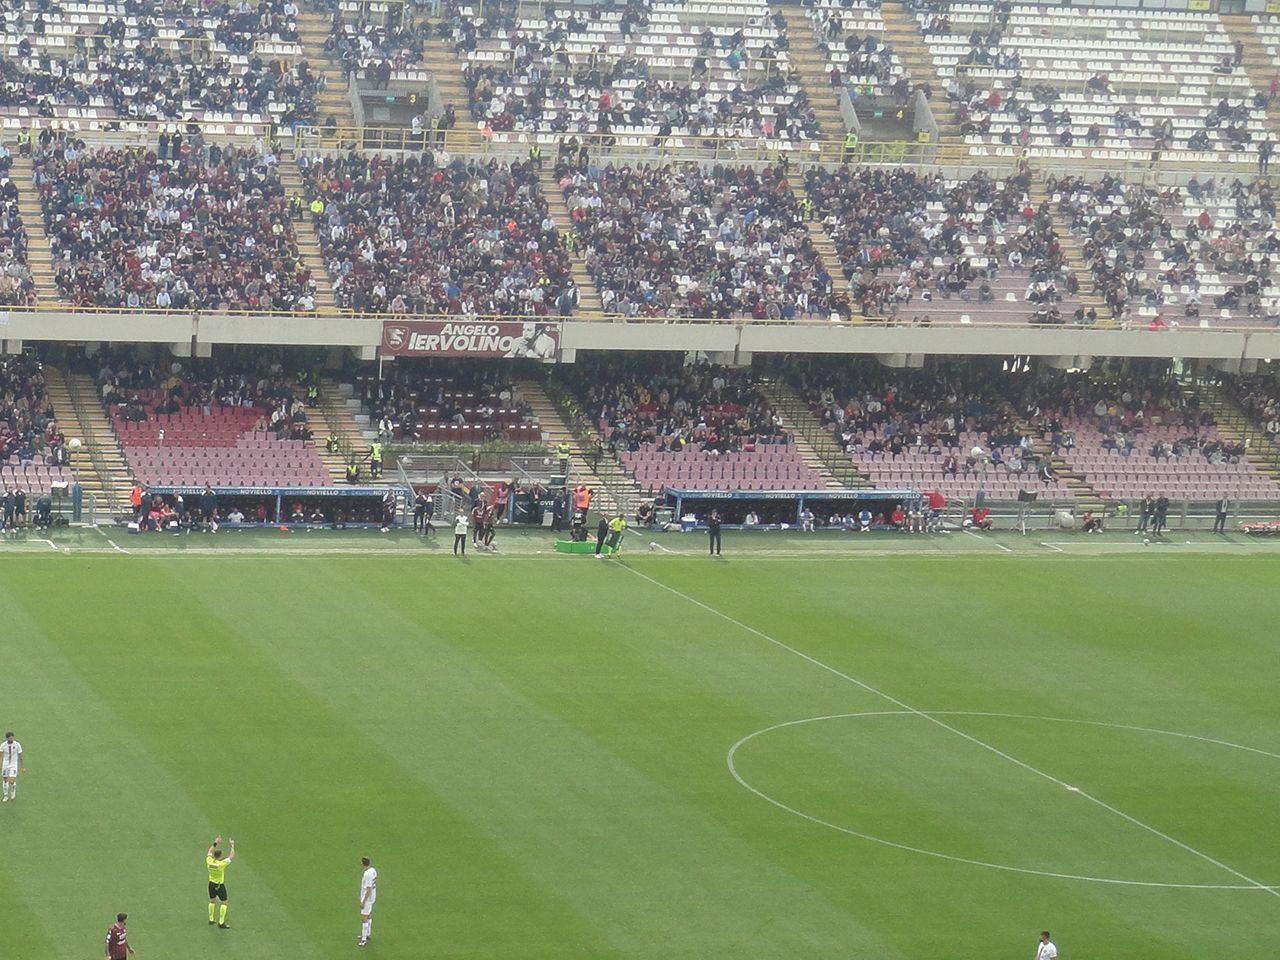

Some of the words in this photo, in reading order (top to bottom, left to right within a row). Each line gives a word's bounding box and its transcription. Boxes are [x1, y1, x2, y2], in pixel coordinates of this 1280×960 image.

[409, 94, 416, 103] 3
[440, 323, 500, 336] ANGELO
[408, 332, 514, 352] IERVOLINO
